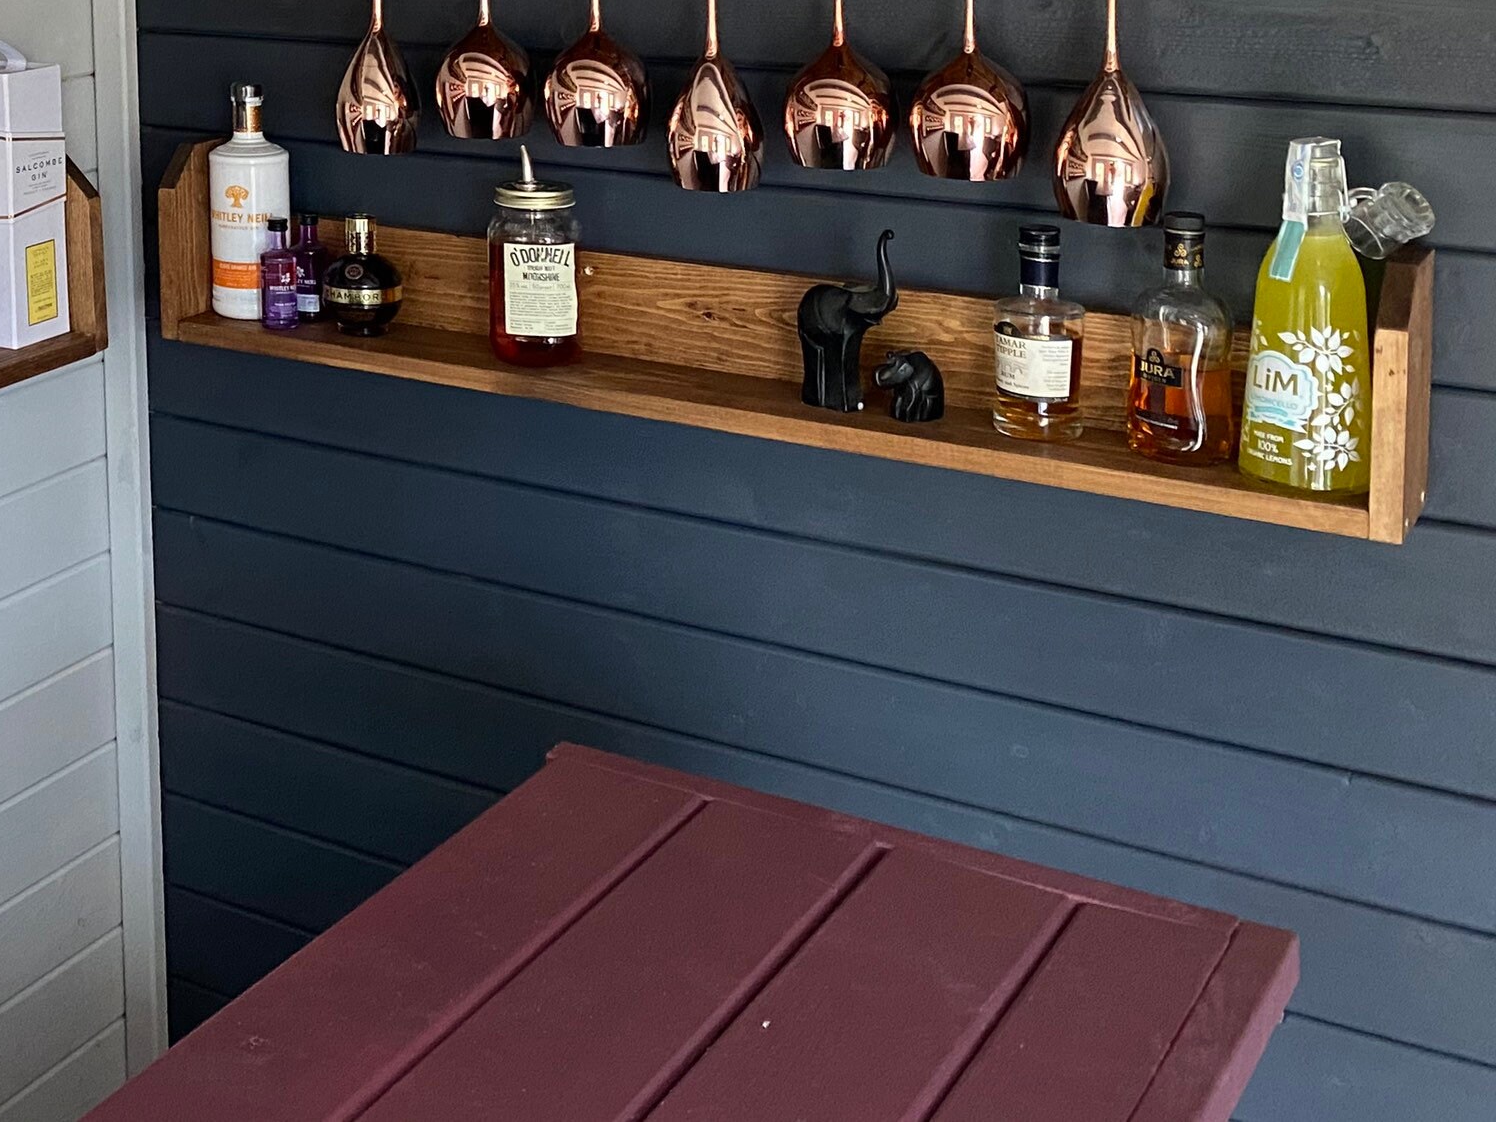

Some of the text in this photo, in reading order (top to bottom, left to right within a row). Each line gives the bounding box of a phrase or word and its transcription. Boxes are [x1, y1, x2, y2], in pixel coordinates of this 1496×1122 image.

[16, 157, 63, 174] SALCOMBE
[1140, 360, 1176, 379] JURA
[1253, 365, 1299, 396] LiM
